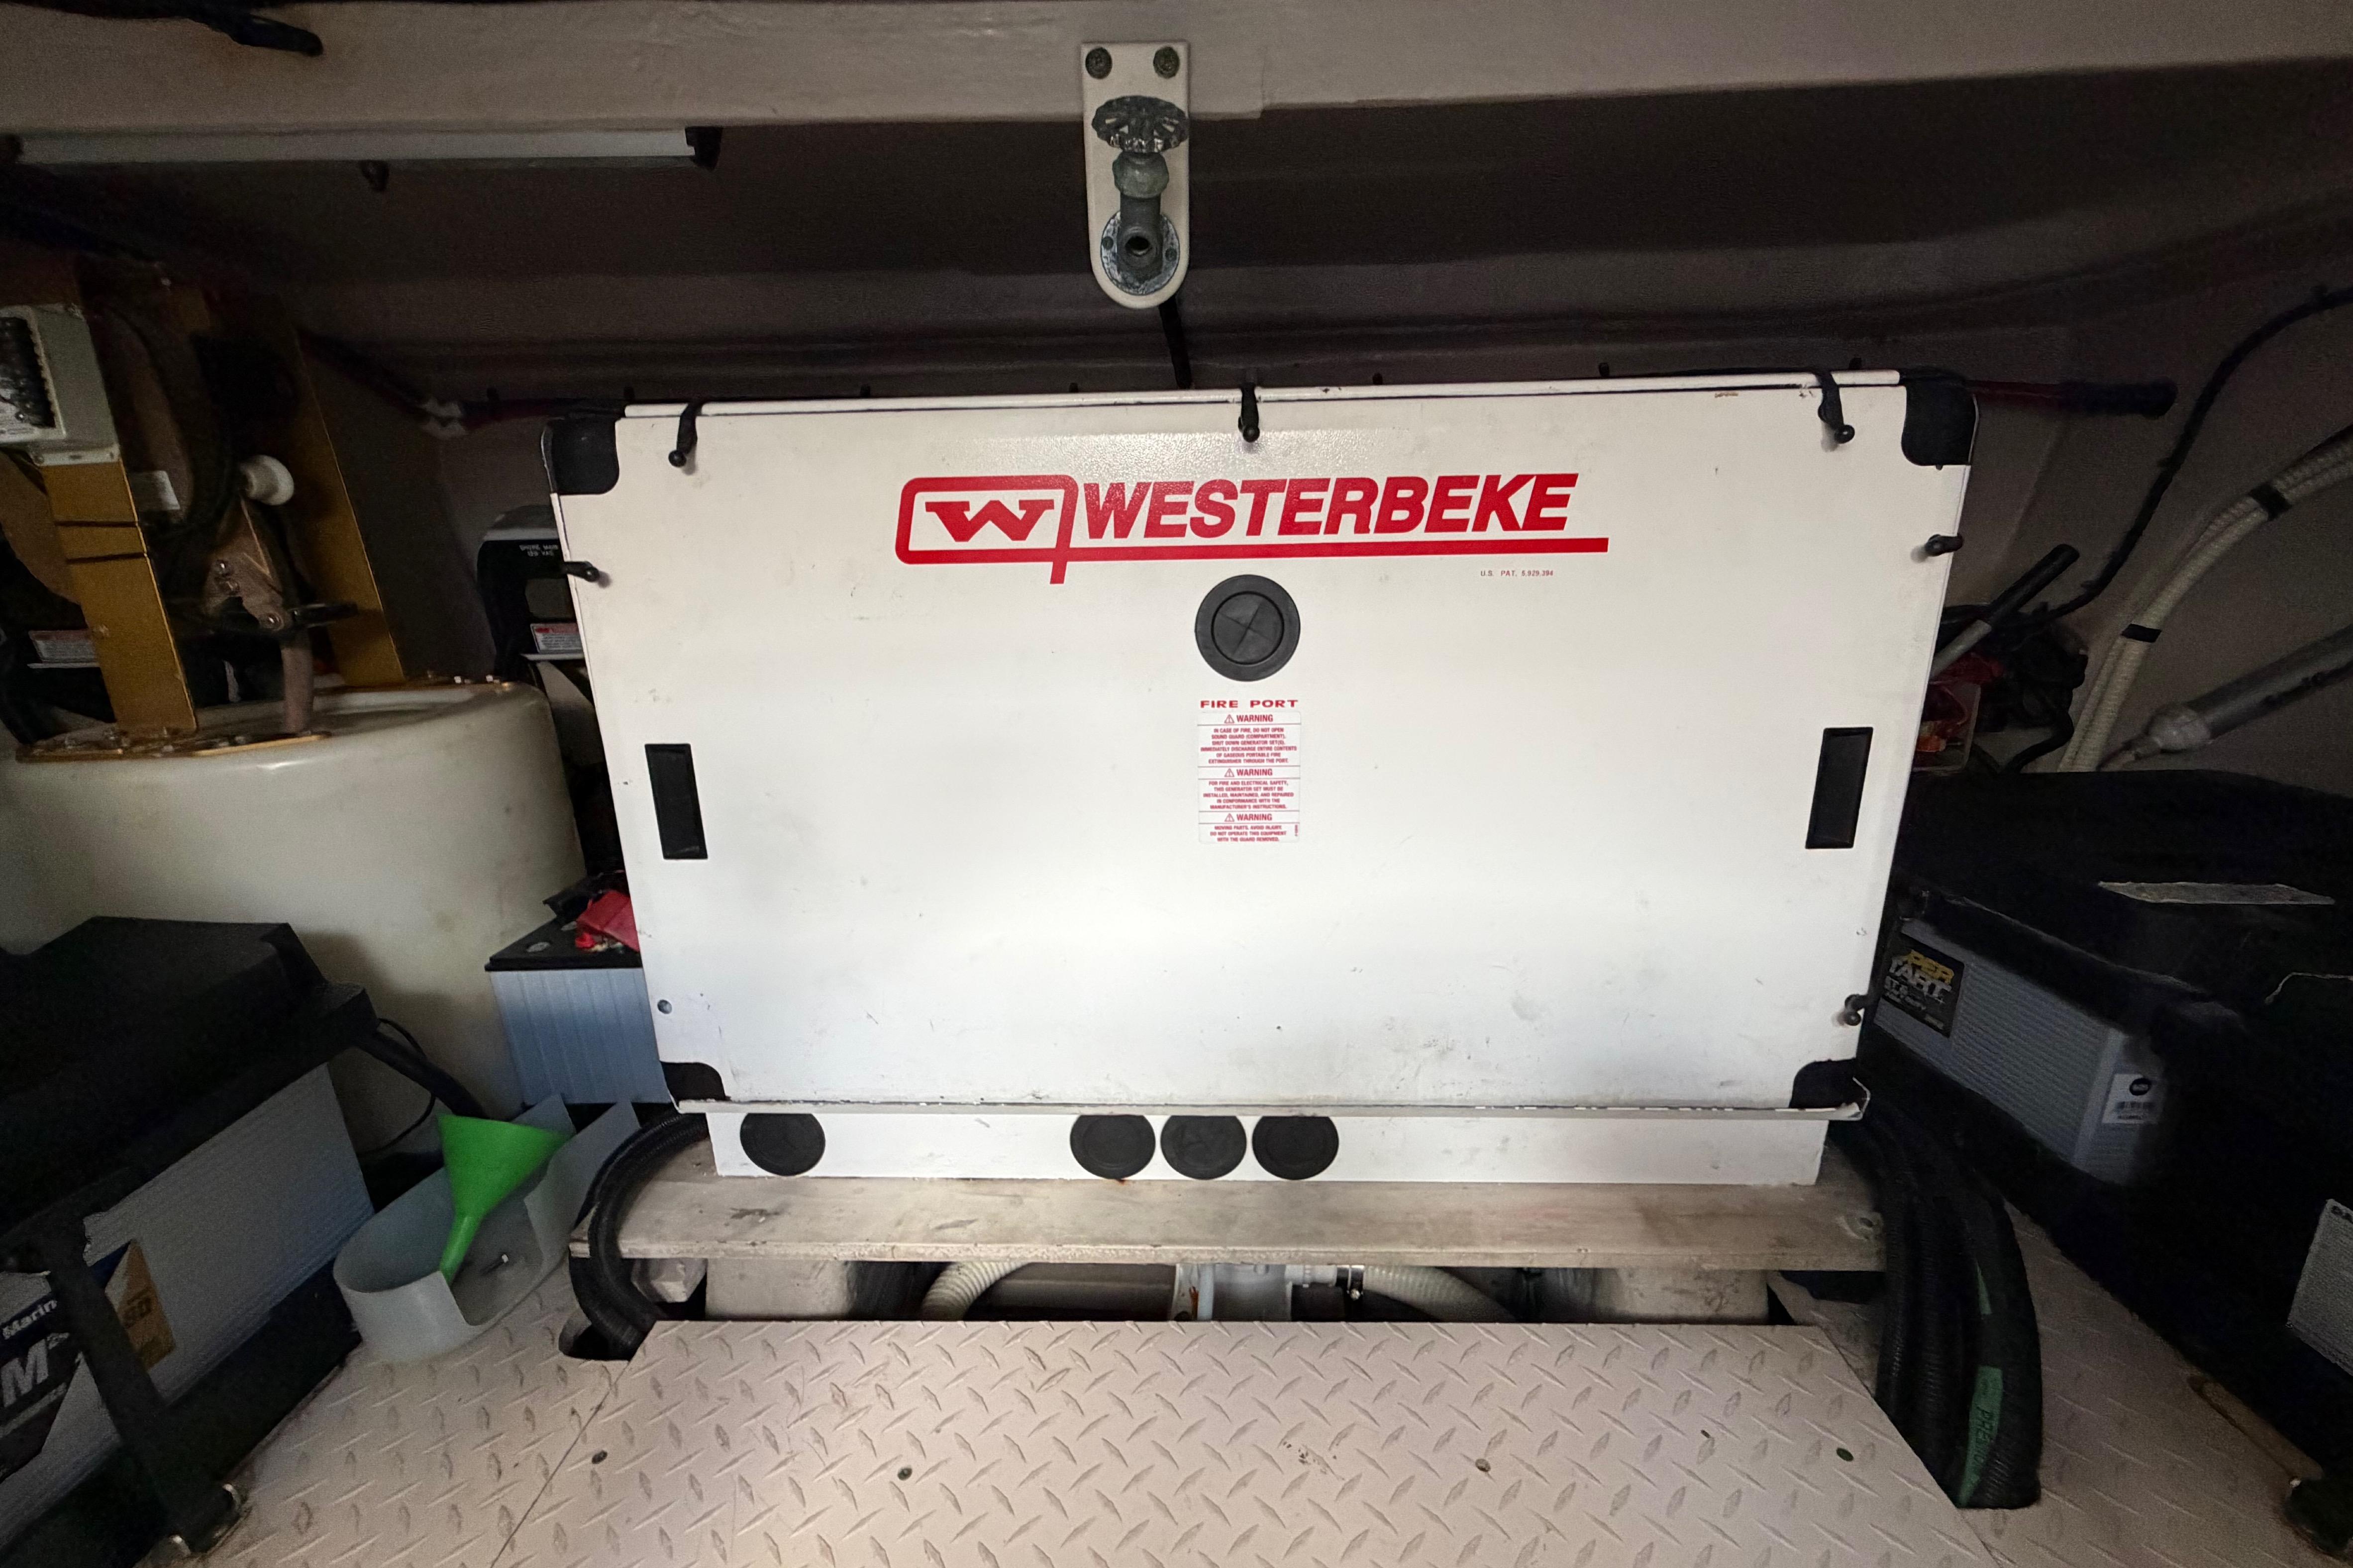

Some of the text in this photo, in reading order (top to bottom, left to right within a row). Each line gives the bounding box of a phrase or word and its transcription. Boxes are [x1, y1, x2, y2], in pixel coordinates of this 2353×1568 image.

[1084, 474, 1578, 539] WESTERBEKE
[1889, 956, 1952, 997] TART
[1903, 949, 1954, 984] PER
[3, 1299, 58, 1340] Marin
